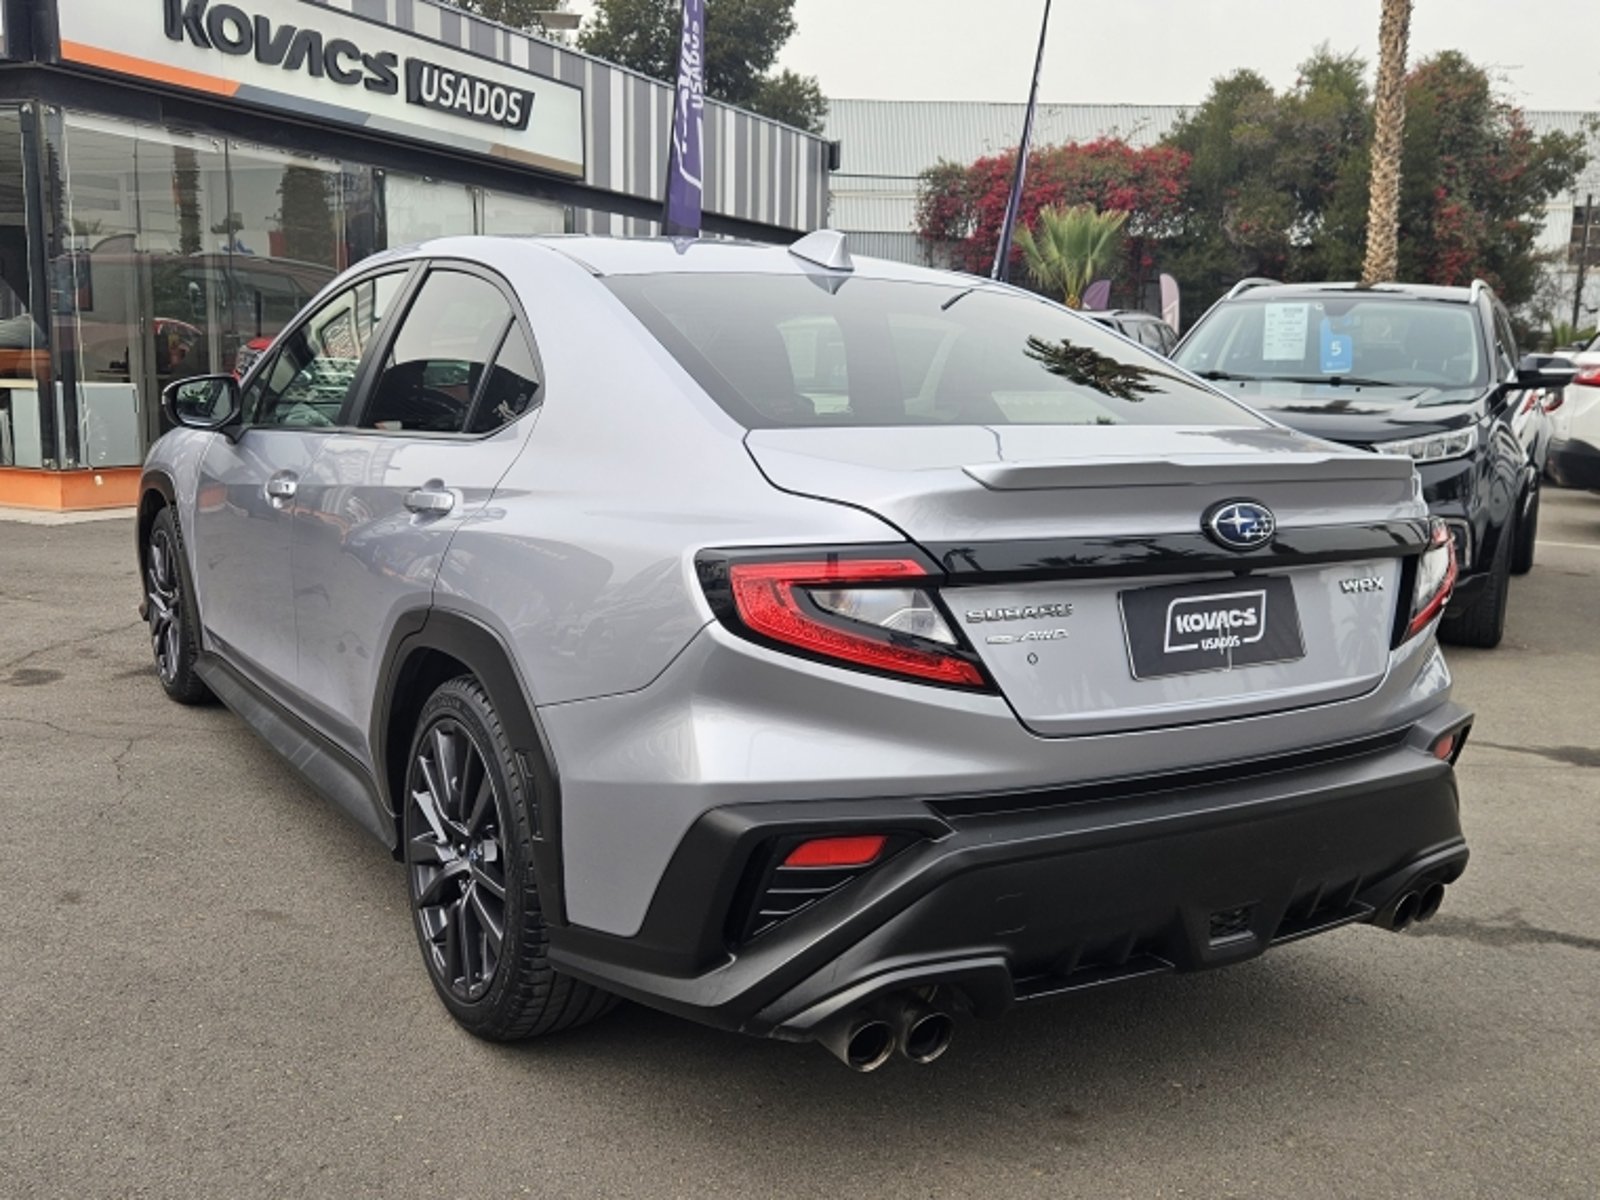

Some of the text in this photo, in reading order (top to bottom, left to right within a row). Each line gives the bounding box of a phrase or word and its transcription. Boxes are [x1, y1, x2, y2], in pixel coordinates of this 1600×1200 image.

[163, 0, 523, 126] KOVACS USADOS
[1330, 340, 1342, 357] 5
[1338, 576, 1384, 594] WRX
[966, 603, 1074, 623] SUBARU
[1175, 607, 1257, 634] KOVACS
[1201, 635, 1241, 651] USADOS
